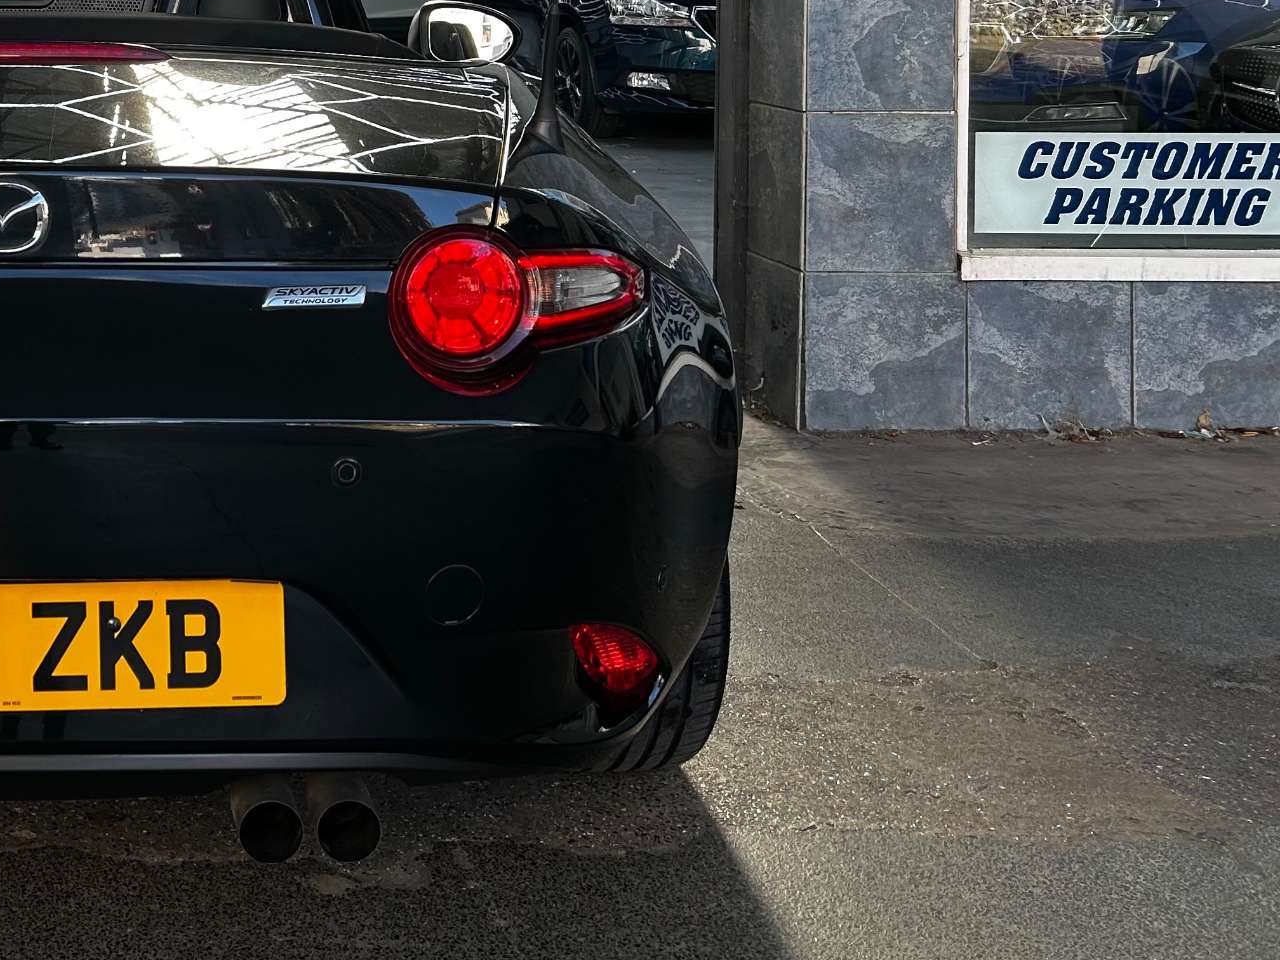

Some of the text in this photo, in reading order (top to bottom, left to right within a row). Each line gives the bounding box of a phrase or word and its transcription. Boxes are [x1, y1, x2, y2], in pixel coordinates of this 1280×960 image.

[1042, 187, 1272, 227] PARKING
[275, 287, 357, 296] SKYACTIV
[31, 598, 222, 692] ZKB
